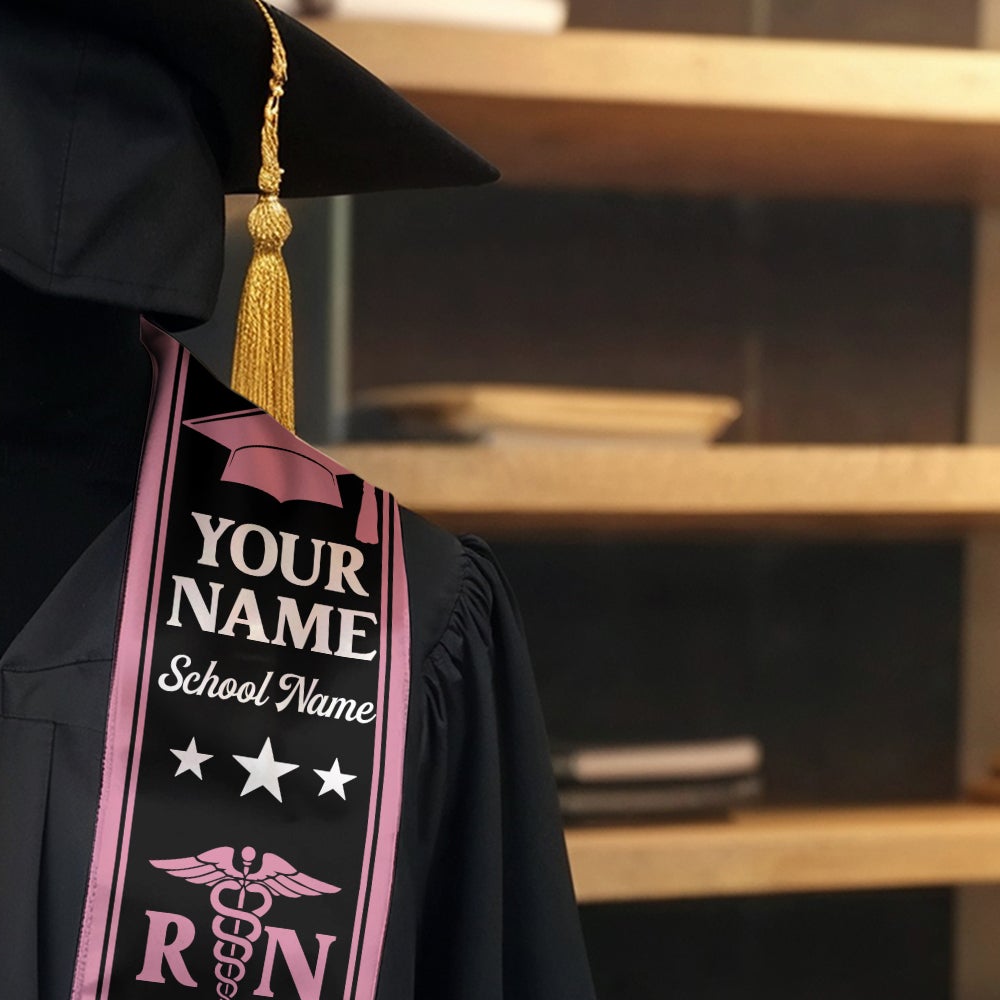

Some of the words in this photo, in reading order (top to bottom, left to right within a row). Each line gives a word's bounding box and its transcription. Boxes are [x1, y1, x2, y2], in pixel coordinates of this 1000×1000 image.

[191, 511, 370, 597] YOUR
[166, 574, 379, 662] NAME
[157, 653, 274, 707] School
[274, 672, 378, 724] Name
